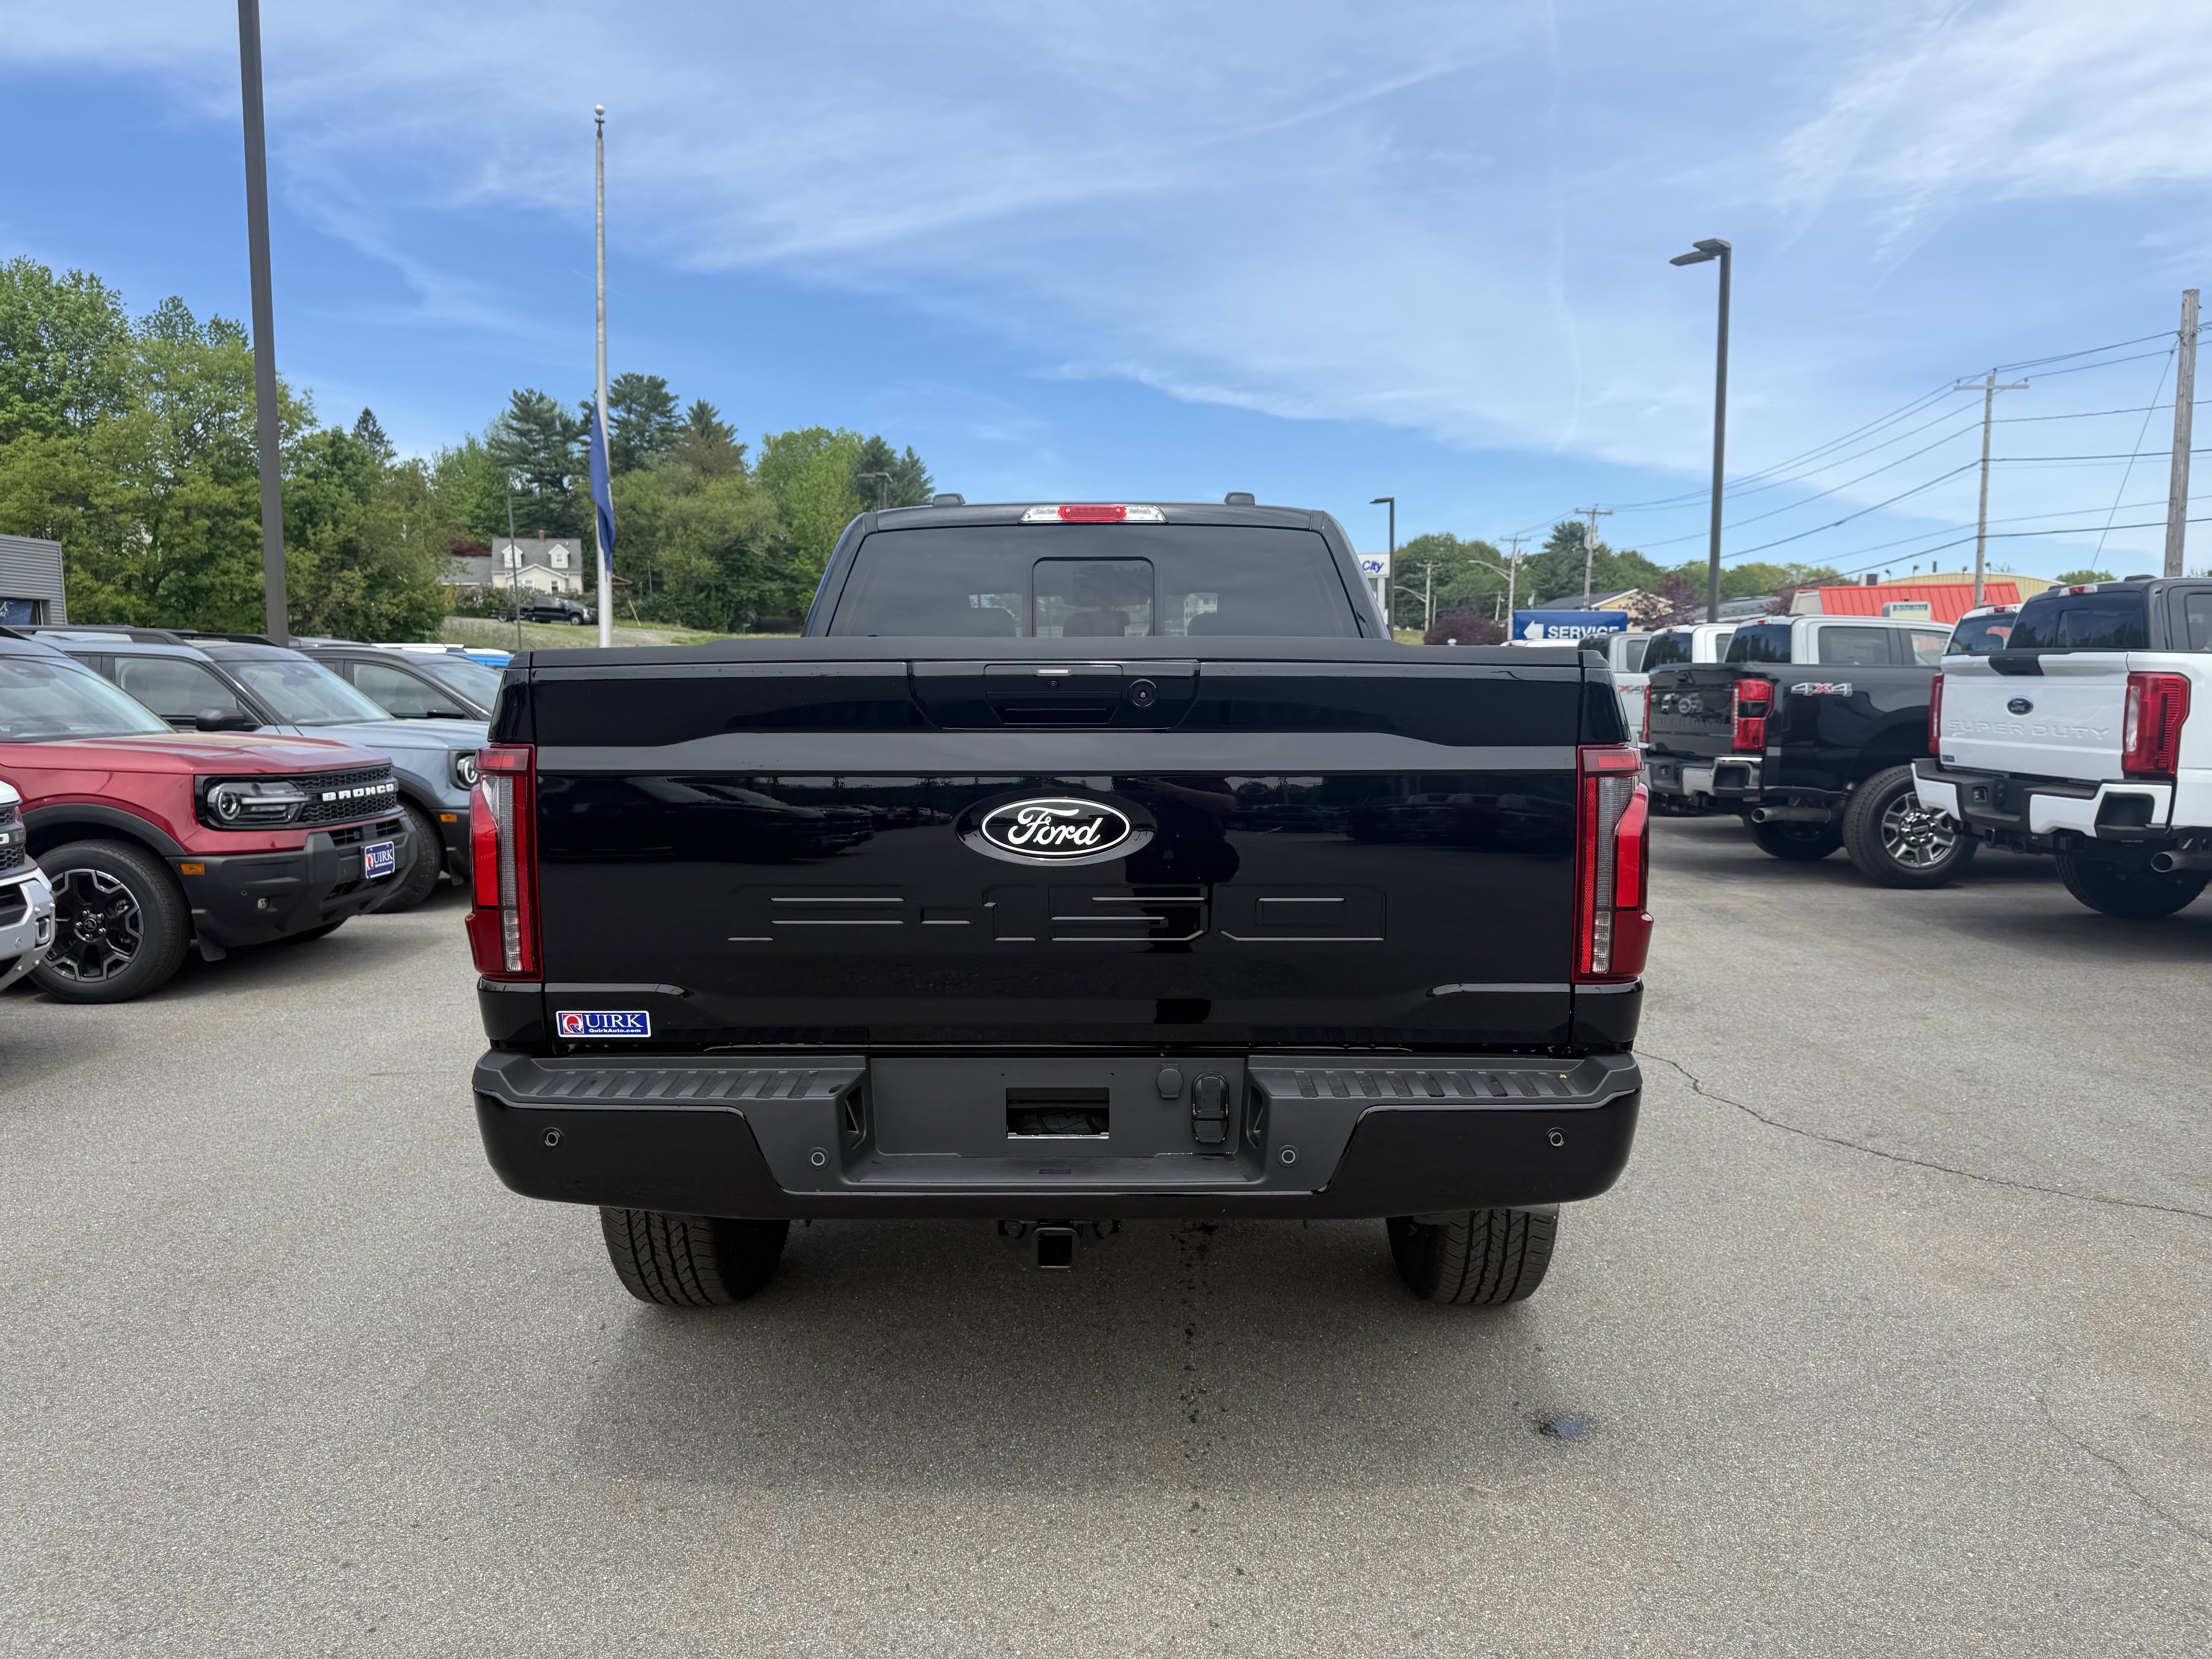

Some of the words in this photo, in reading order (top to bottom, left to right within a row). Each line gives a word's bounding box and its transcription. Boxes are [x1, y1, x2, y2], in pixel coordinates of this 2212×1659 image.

[1362, 560, 1384, 573] City
[1947, 720, 2025, 735] SUPER
[2032, 724, 2109, 740] DUTY
[322, 783, 394, 802] BRONCO
[1008, 807, 1103, 845] Ford
[366, 849, 393, 871] QUIRK
[727, 884, 1386, 941] F-150
[563, 1014, 644, 1033] QUIRK
